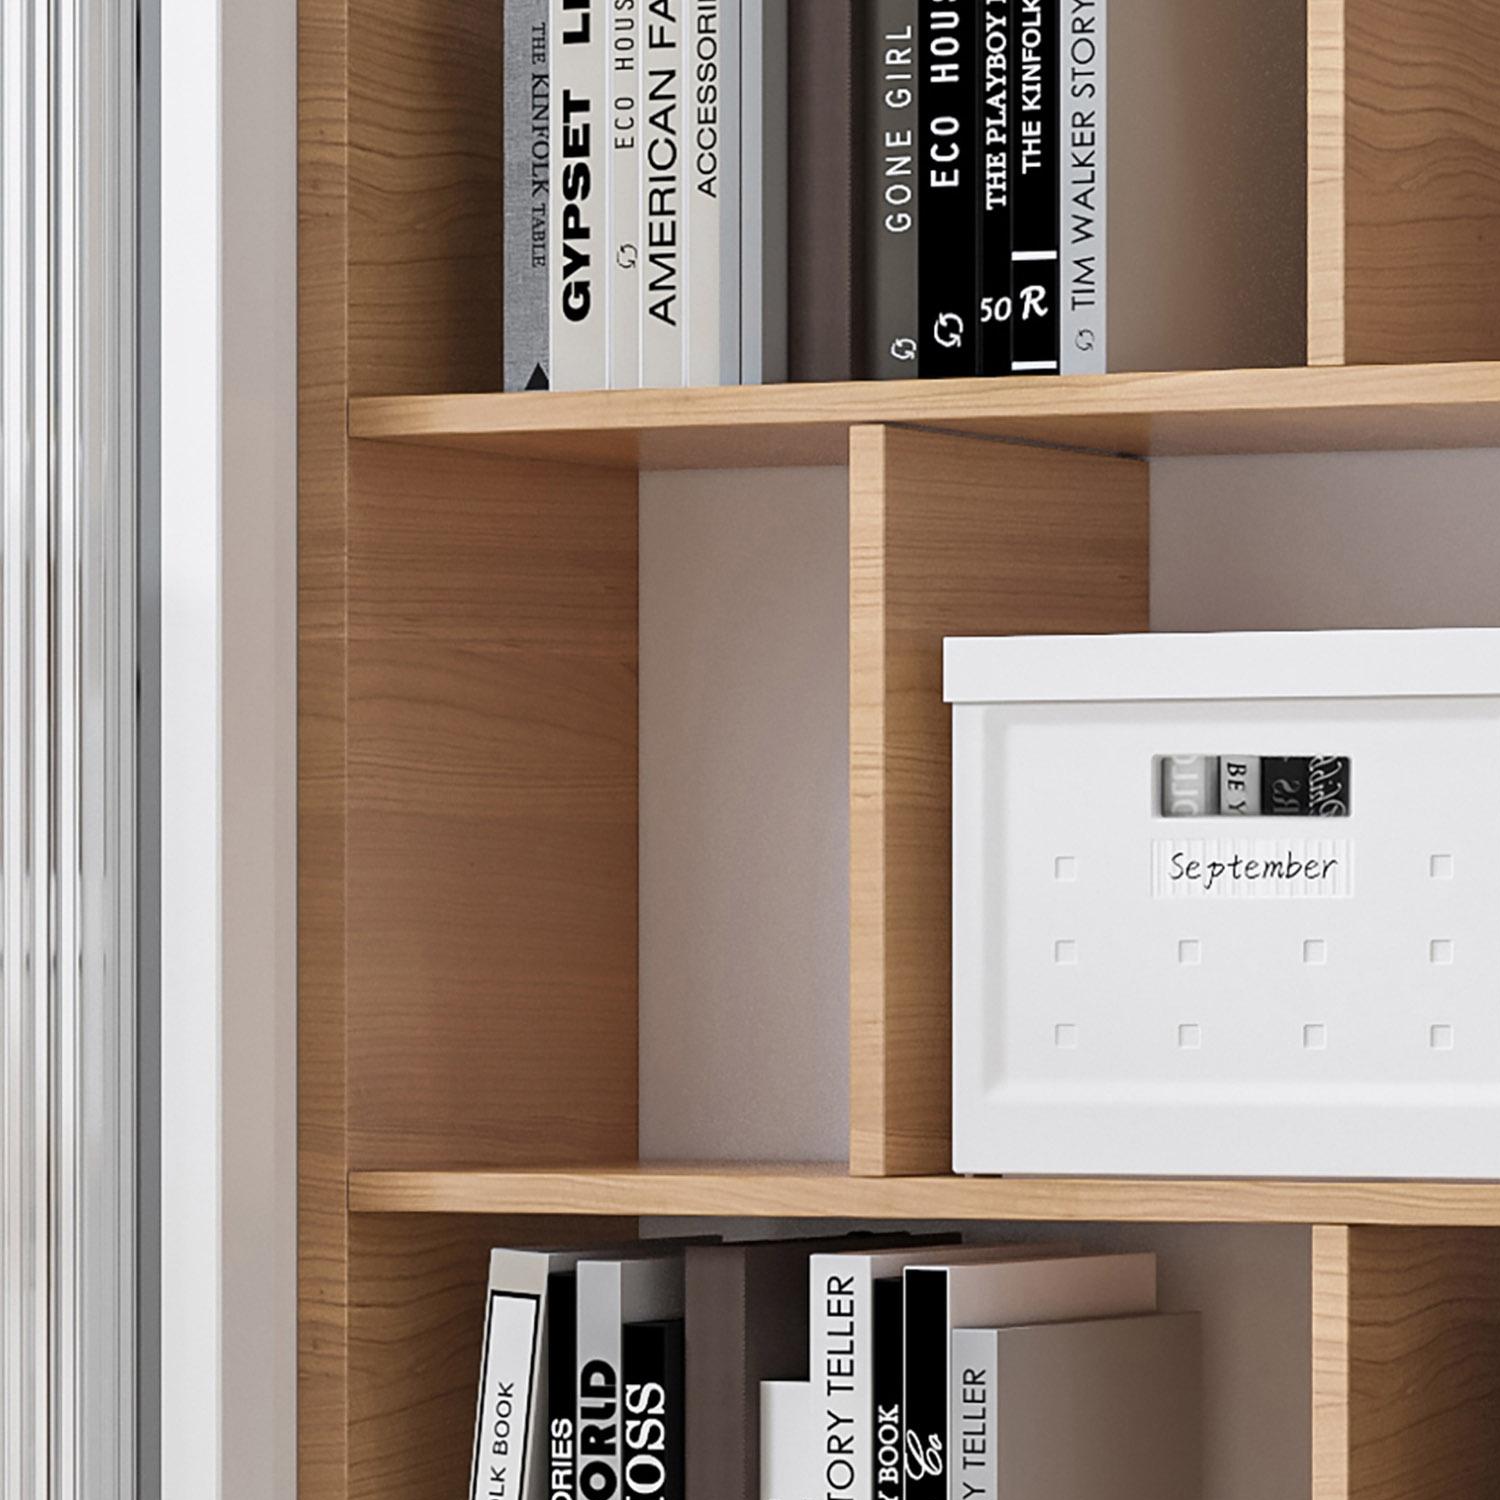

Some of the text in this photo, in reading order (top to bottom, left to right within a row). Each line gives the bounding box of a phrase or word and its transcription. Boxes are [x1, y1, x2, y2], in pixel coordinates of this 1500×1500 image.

[531, 22, 549, 268] THE KINFOLK TABLE
[614, 96, 634, 149] ECO
[697, 0, 718, 198] ACCESSORI
[885, 25, 912, 233] GONE GIRL
[930, 0, 960, 188] ECO HOU
[986, 11, 1007, 211] THE PLAYBOY
[1022, 0, 1042, 175] THE KINFOLK
[1071, 0, 1096, 311] TIM WALKER STORY
[562, 89, 591, 322] GYPSET
[648, 70, 677, 326] AMERICAN
[980, 296, 1012, 323] 50
[1019, 284, 1049, 320] R
[1168, 851, 1338, 889] September
[827, 1275, 854, 1396] TELLER
[492, 1382, 514, 1455] BOOK
[878, 1404, 899, 1484] BOOK
[905, 1429, 943, 1481] Co
[963, 1368, 986, 1470] TELLER
